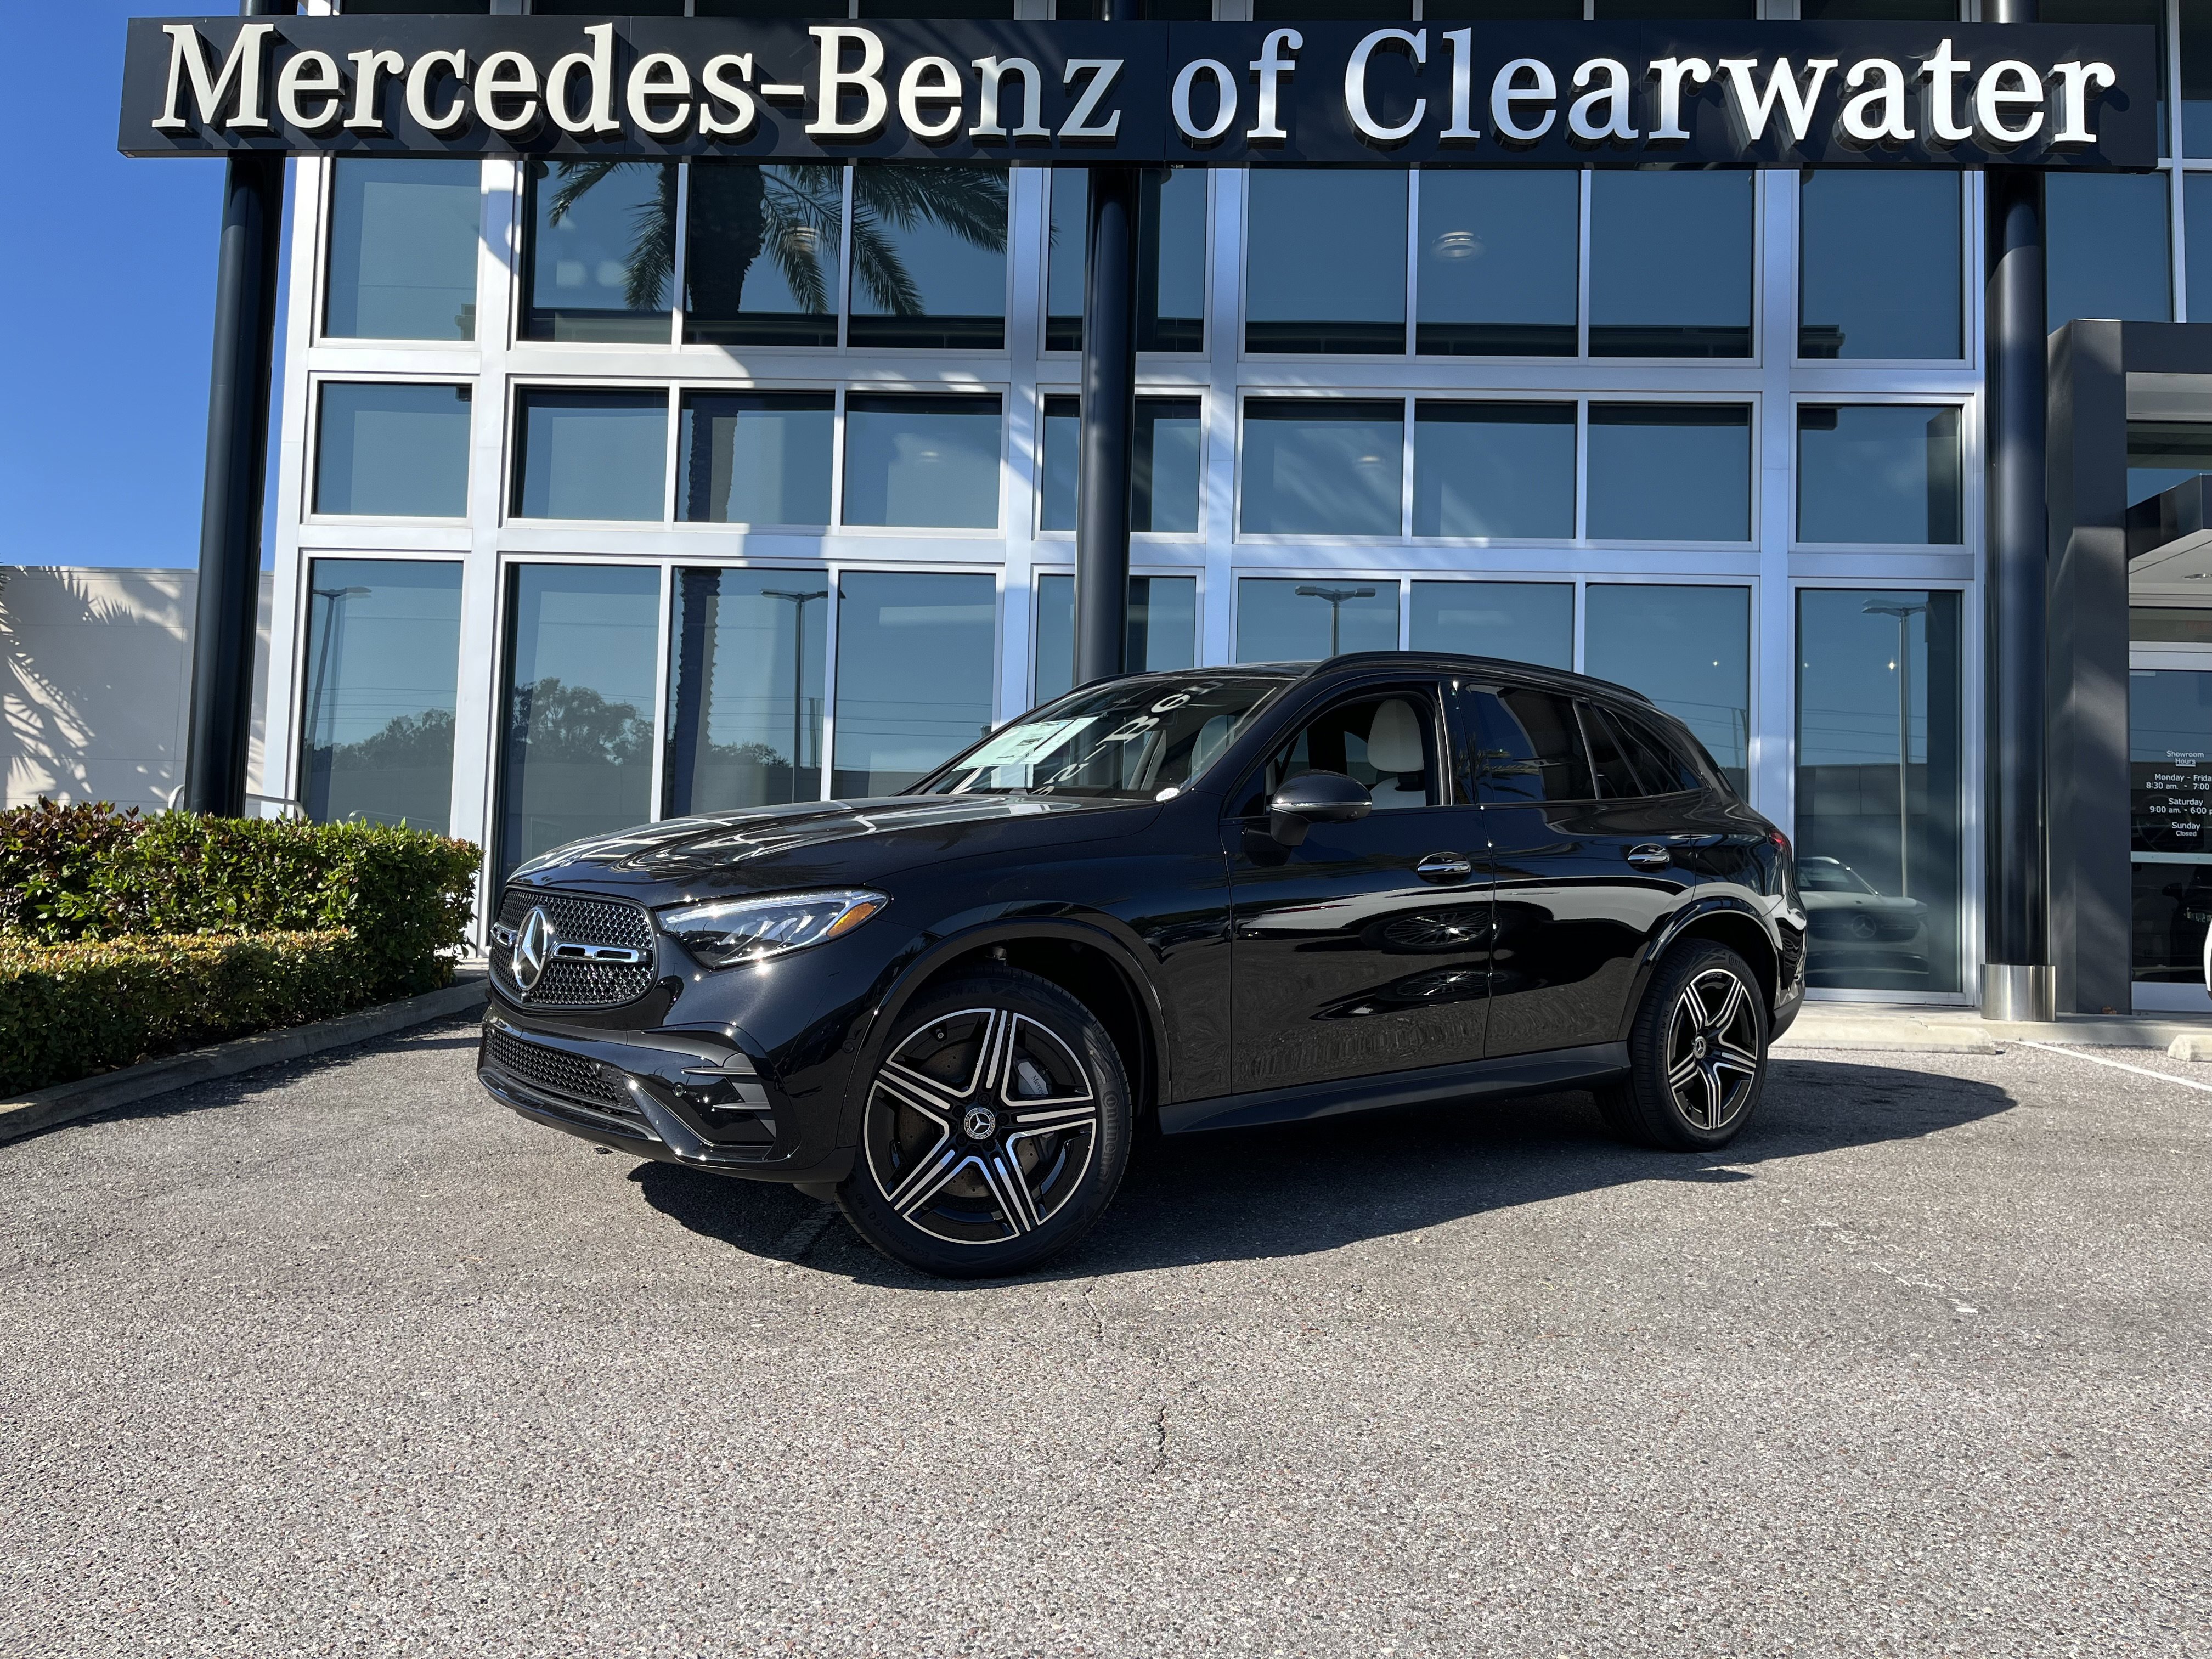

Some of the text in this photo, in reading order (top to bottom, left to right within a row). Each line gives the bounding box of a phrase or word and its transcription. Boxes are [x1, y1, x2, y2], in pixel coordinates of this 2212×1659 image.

[151, 22, 2116, 145] Mercedes-Benz of Clearwater
[2154, 773, 2185, 782] Monday
[2168, 797, 2203, 806] Saturday
[2172, 822, 2200, 831] Sunday
[1098, 1090, 1120, 1186] Continental
